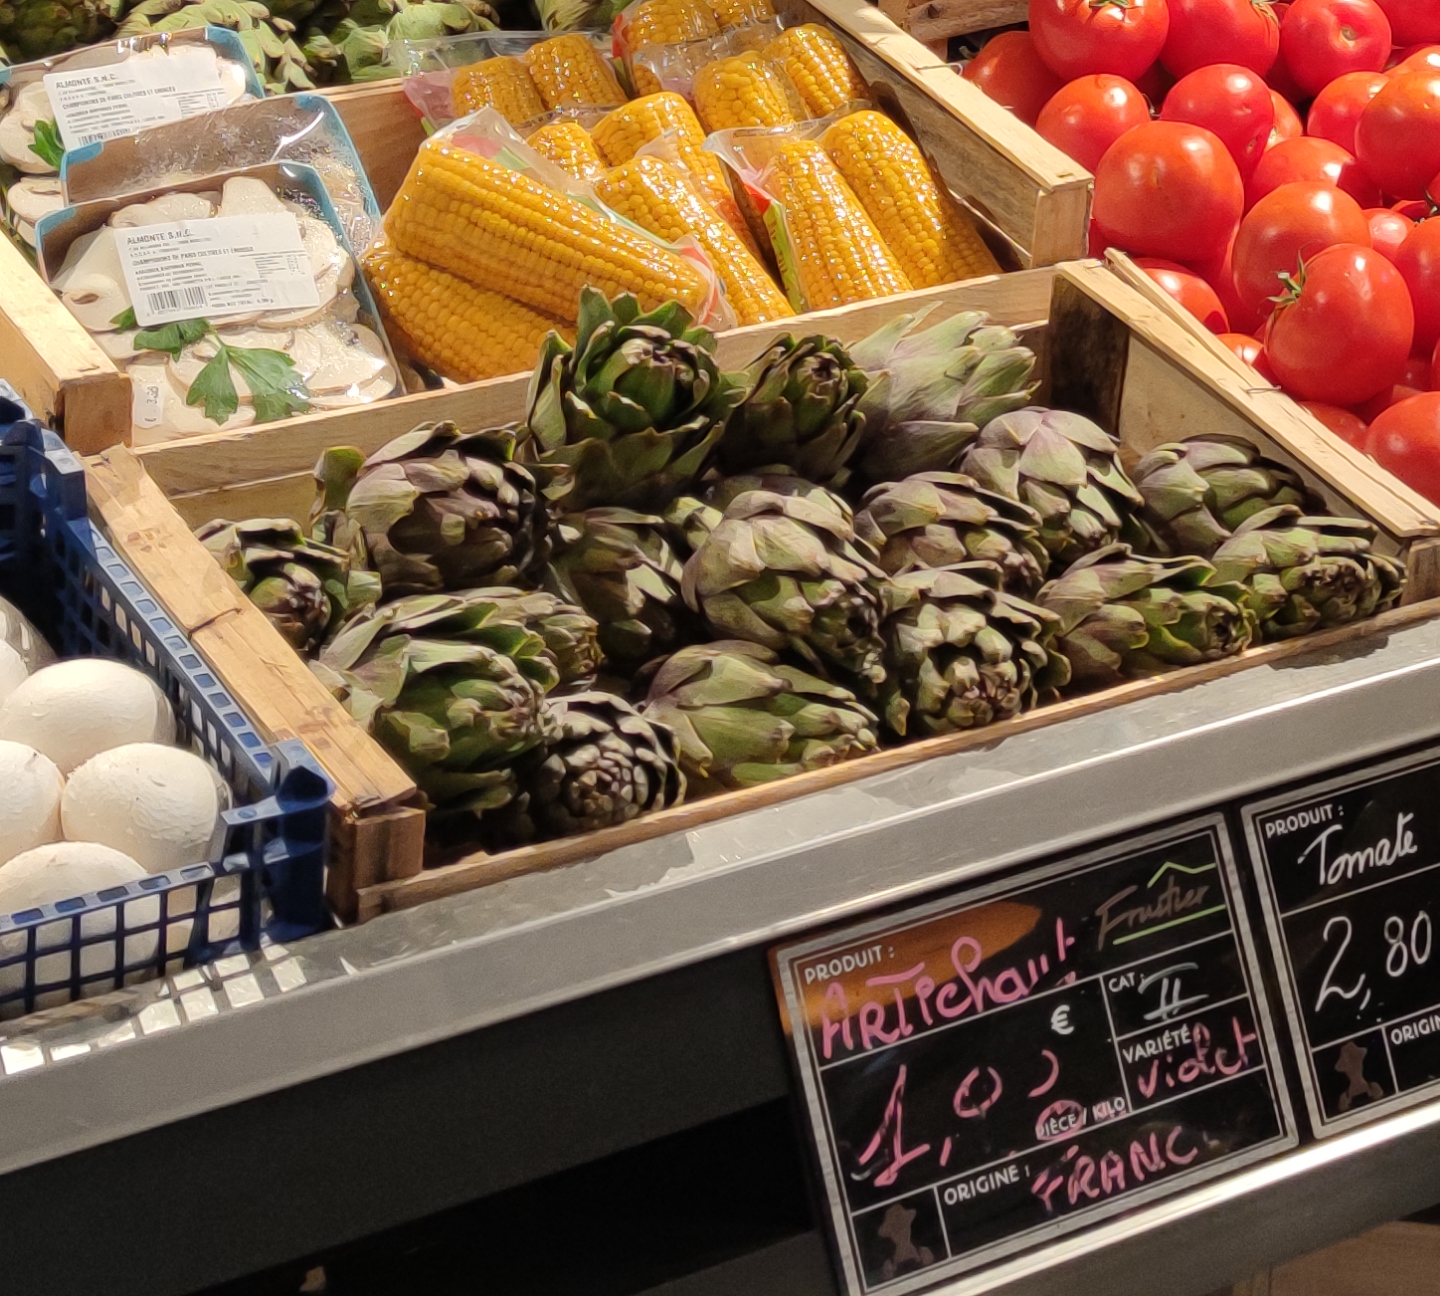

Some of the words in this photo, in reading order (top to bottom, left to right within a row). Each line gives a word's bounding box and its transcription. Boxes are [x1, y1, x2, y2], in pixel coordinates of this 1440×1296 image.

[127, 232, 165, 245] ALMONTE
[1266, 804, 1336, 839] PRODUIT
[1296, 812, 1419, 886] Tomate
[804, 945, 883, 985] PRODUIT
[1314, 910, 1433, 1013] 2,80
[1108, 972, 1137, 994] CAT
[1051, 1004, 1075, 1035] €
[1123, 1026, 1192, 1065] VARIÉTÉ
[1036, 1113, 1077, 1138] PIÈCE
[943, 1164, 1022, 1207] ORIGINE
